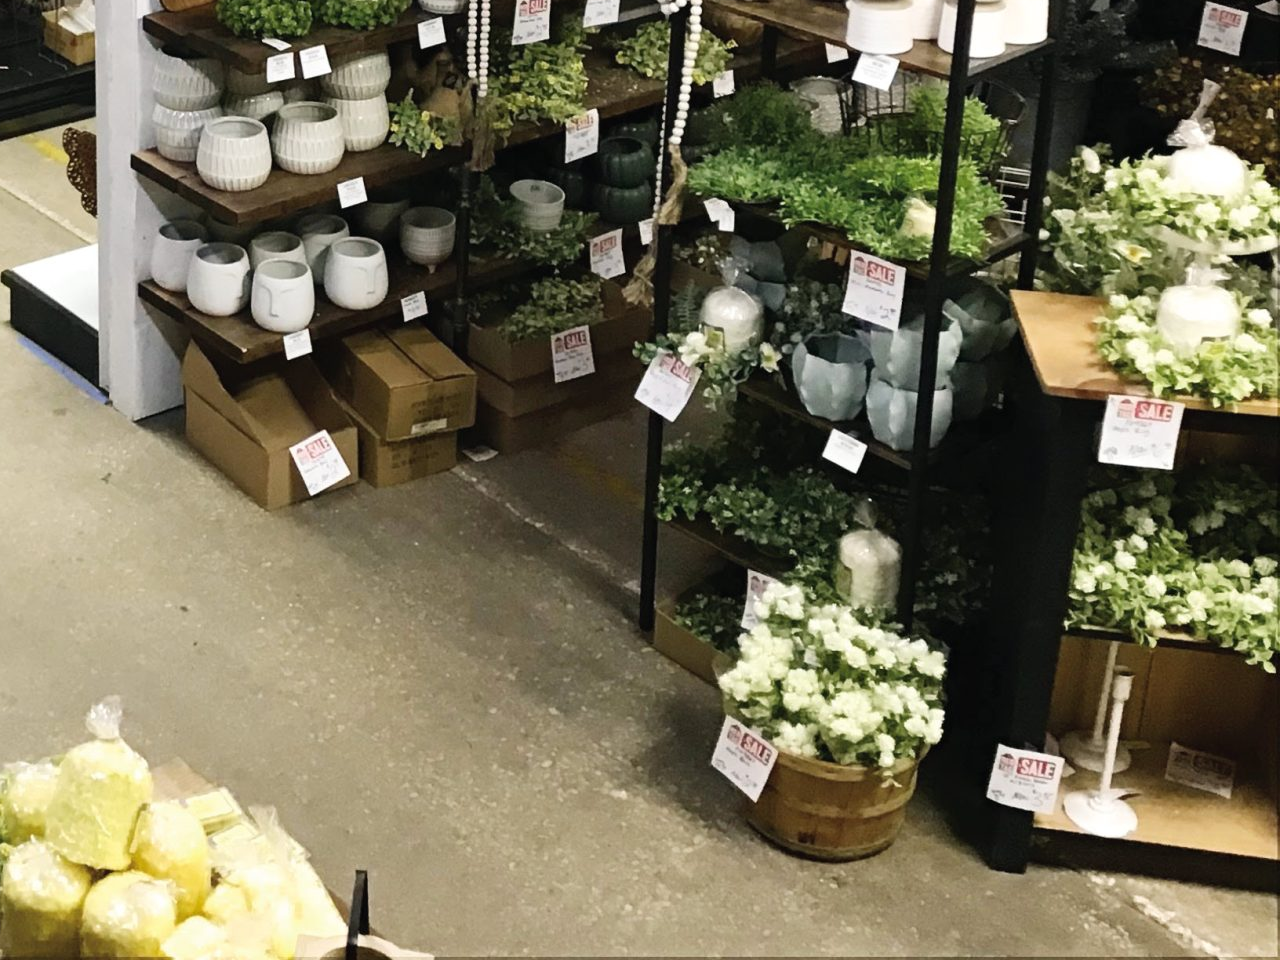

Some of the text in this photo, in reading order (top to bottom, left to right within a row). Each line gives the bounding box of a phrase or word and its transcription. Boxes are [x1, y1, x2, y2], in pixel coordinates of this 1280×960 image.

[867, 262, 895, 286] SALE
[566, 331, 587, 349] SALE
[1138, 401, 1173, 422] SALE
[742, 734, 772, 766] SALE
[1019, 758, 1055, 780] SALE
